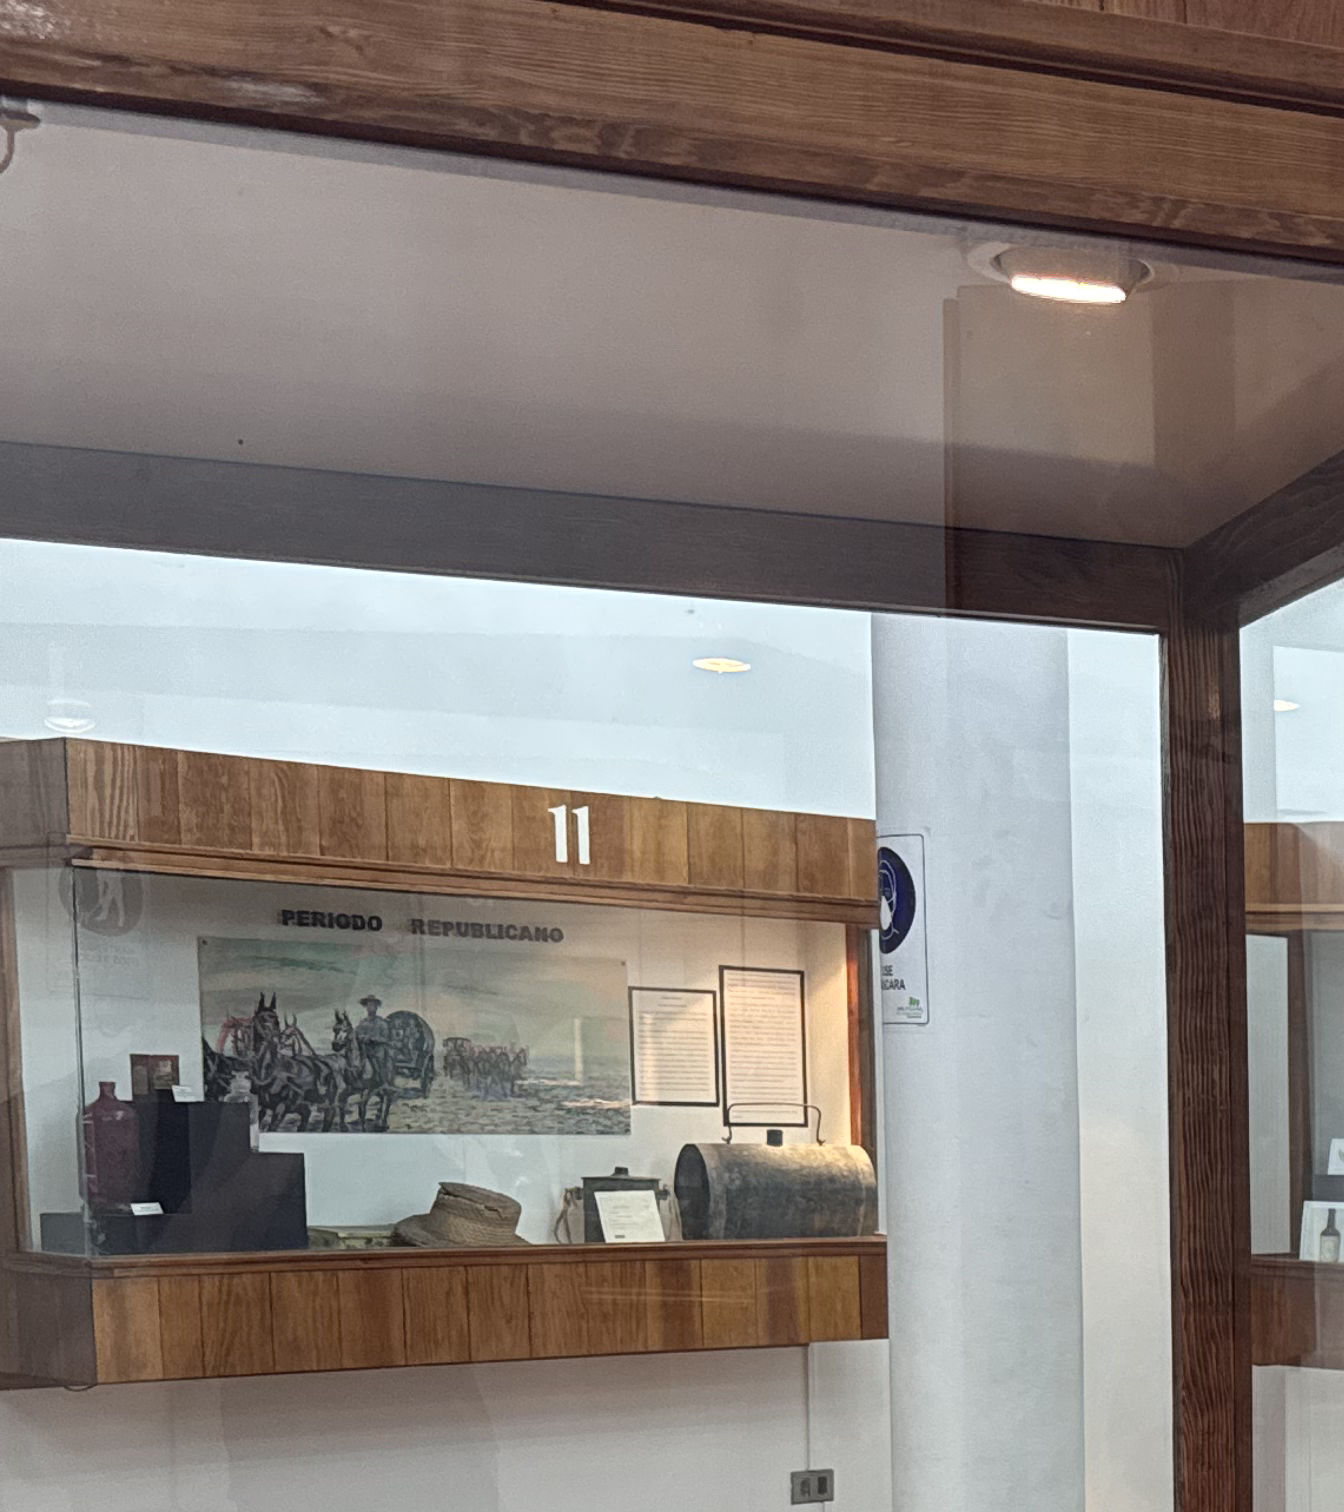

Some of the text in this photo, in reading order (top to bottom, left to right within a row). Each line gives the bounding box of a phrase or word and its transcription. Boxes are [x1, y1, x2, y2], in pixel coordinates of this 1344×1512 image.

[548, 804, 591, 865] 11
[280, 908, 565, 945] PERIODO REPUBLICANO
